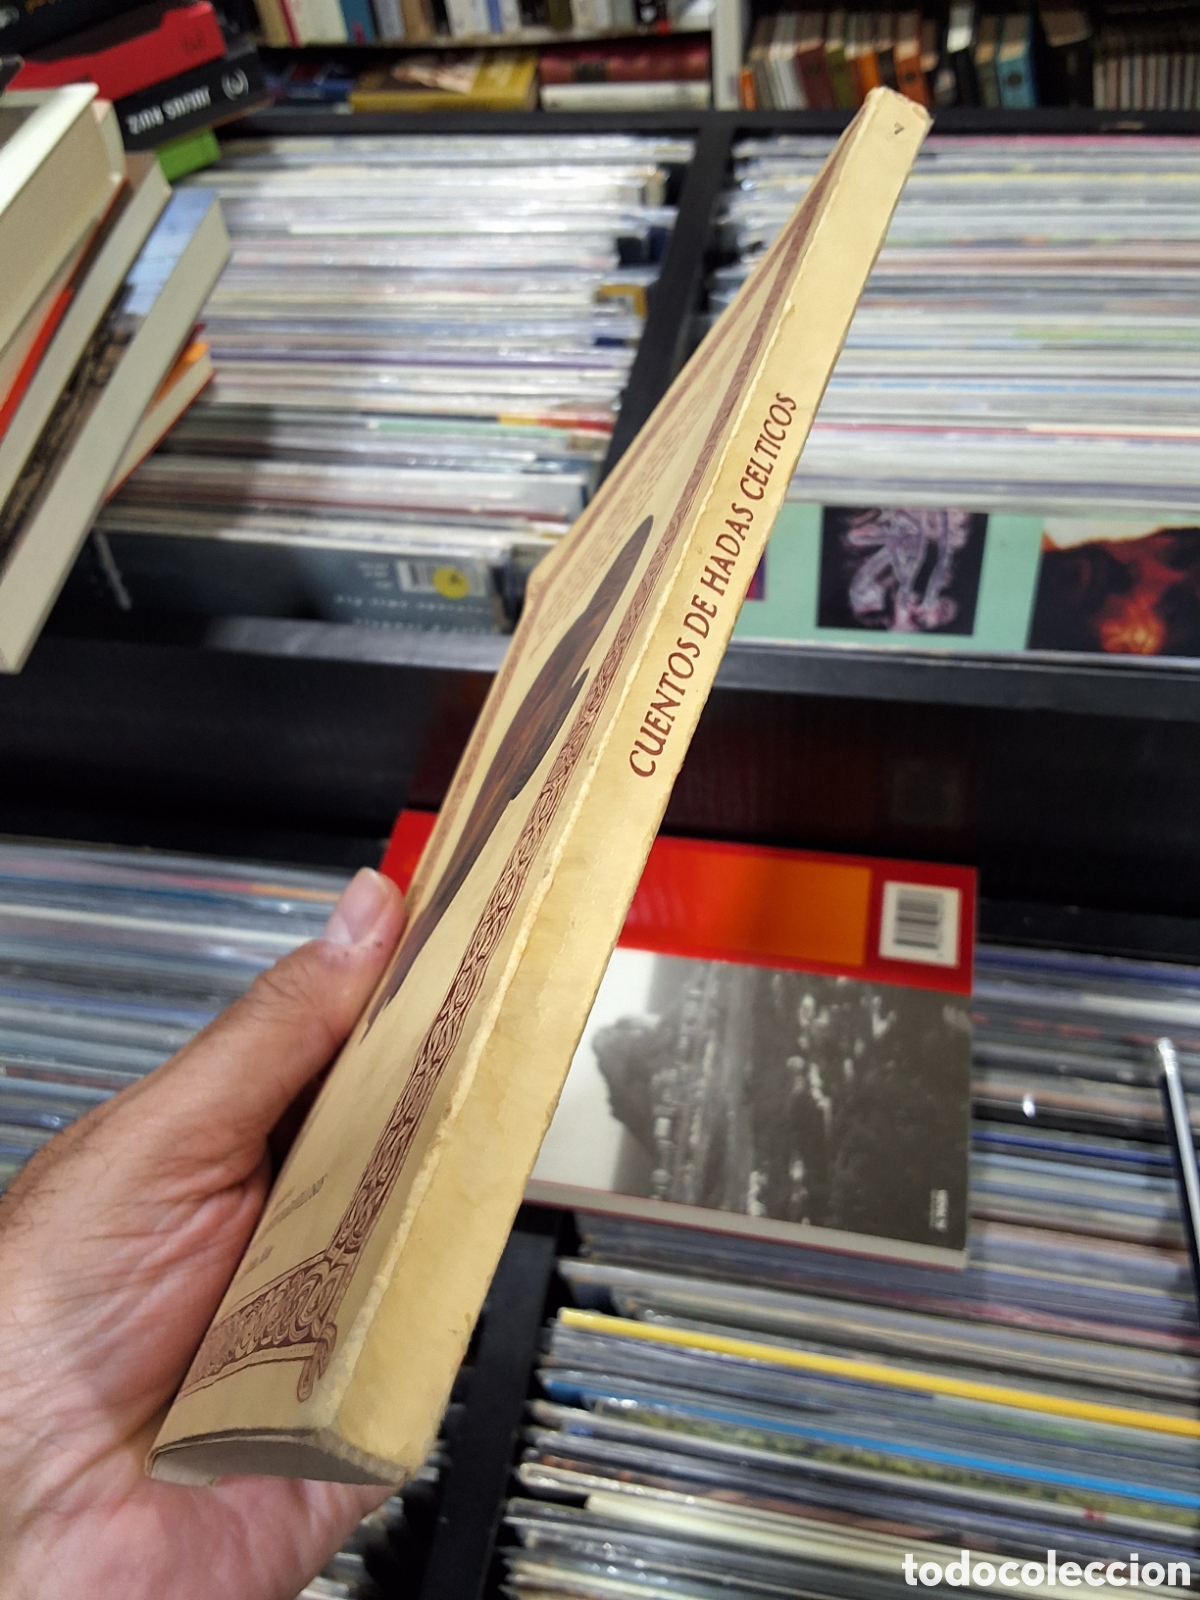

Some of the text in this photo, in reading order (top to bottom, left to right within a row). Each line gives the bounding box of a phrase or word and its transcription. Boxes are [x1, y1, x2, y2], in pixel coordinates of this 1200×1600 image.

[629, 392, 797, 778] CUENTOS DE HADAS CELTICOS
